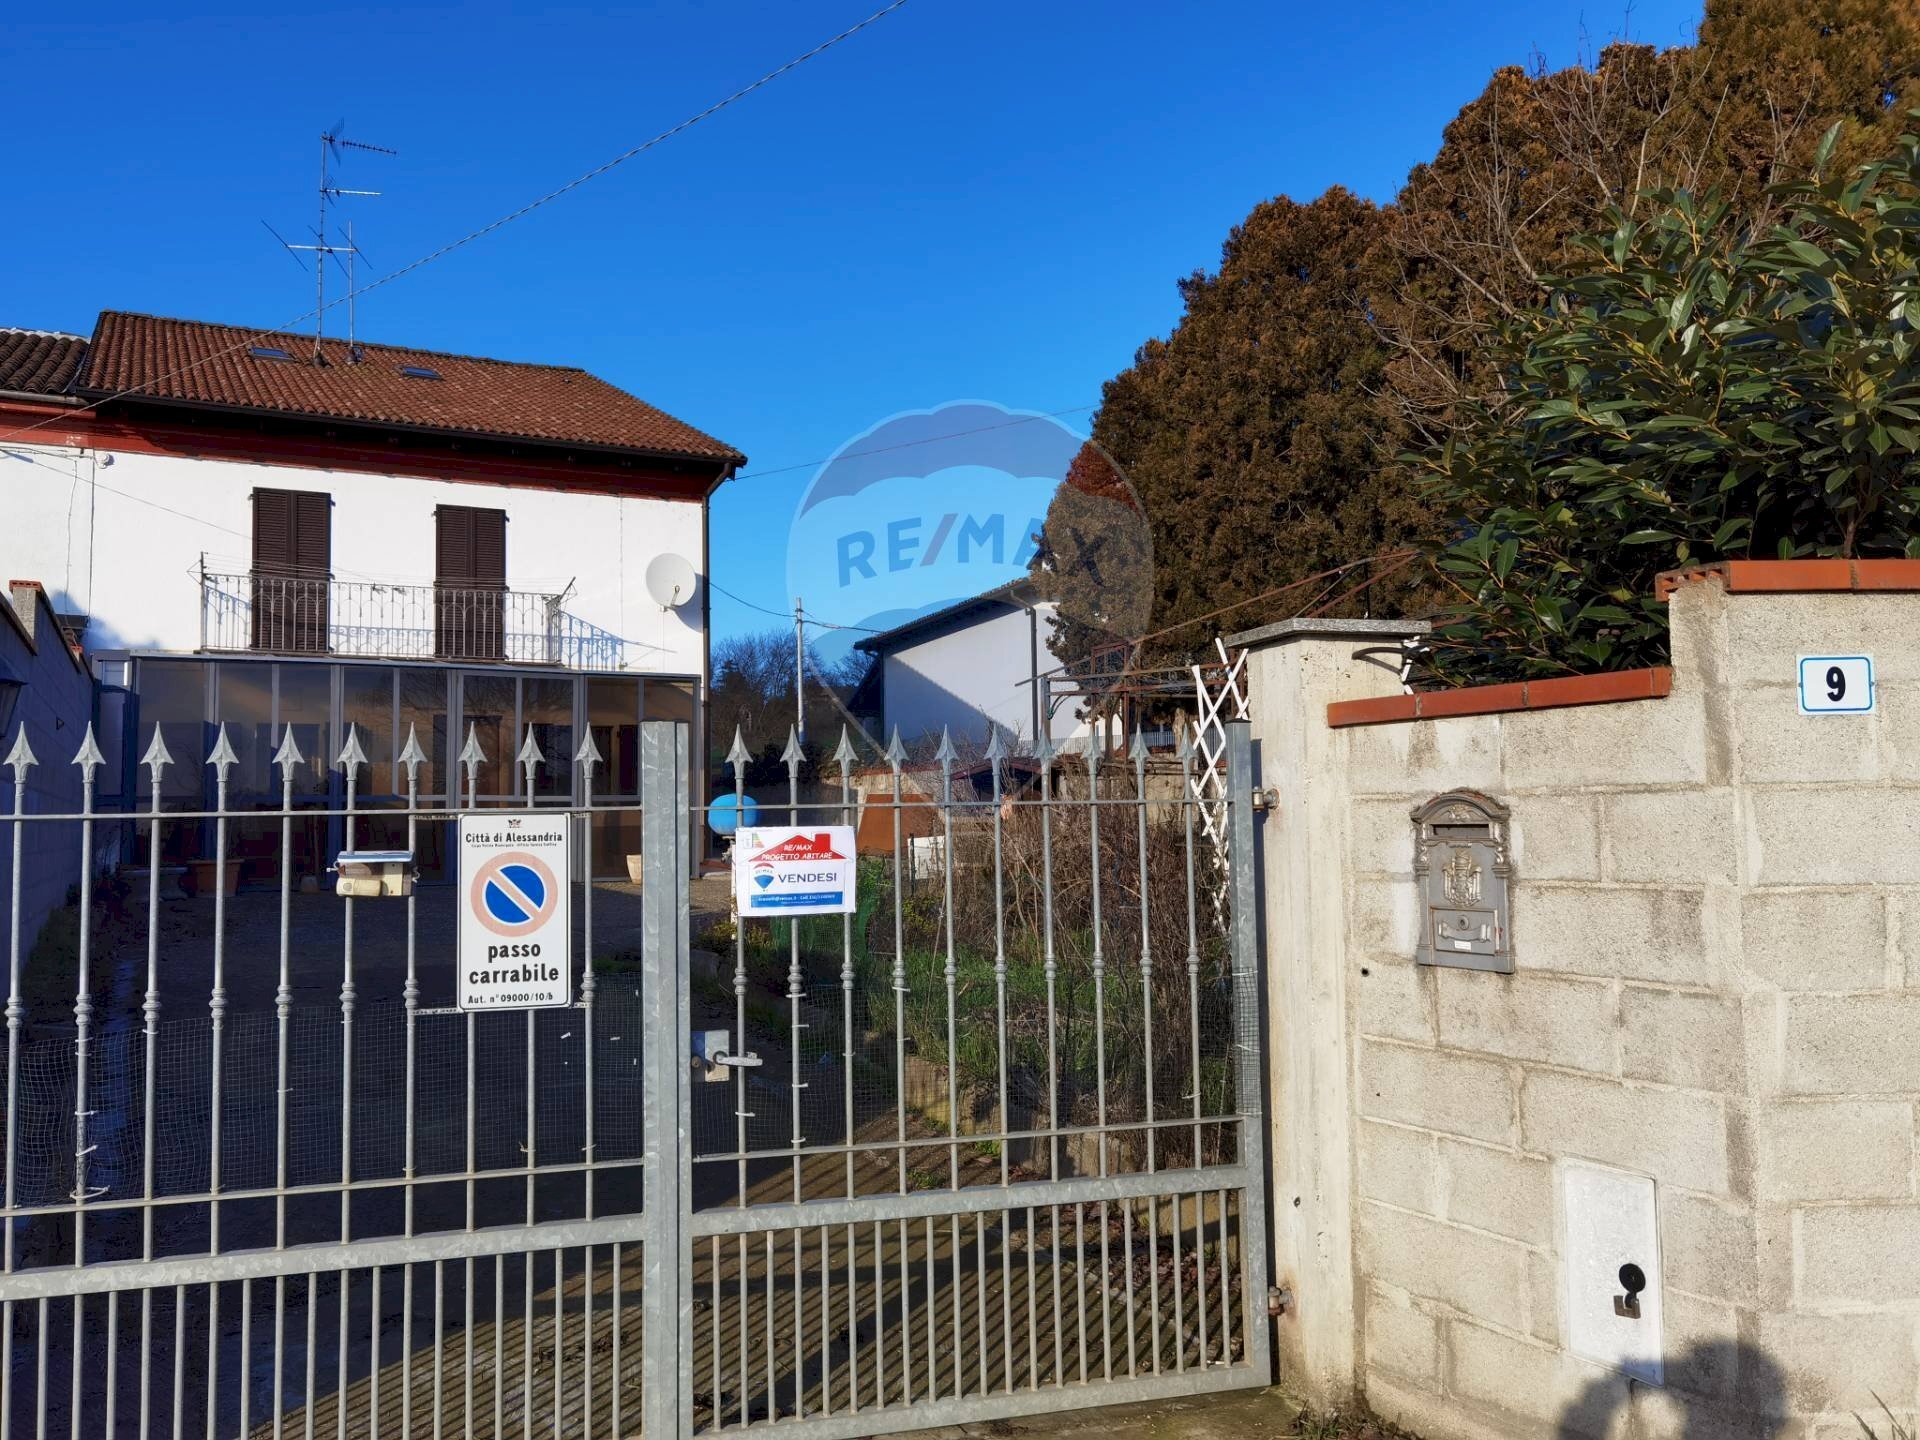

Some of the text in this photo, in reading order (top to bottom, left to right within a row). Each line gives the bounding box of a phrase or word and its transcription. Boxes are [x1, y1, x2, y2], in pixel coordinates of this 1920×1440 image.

[1826, 666, 1846, 702] 9
[465, 832, 562, 843] Città di Alessandria
[761, 852, 833, 861] PROGETTO ABITARE
[778, 872, 837, 883] VENDESI
[488, 944, 541, 963] passo
[469, 963, 559, 984] carrabile
[468, 994, 486, 1004] Aut.
